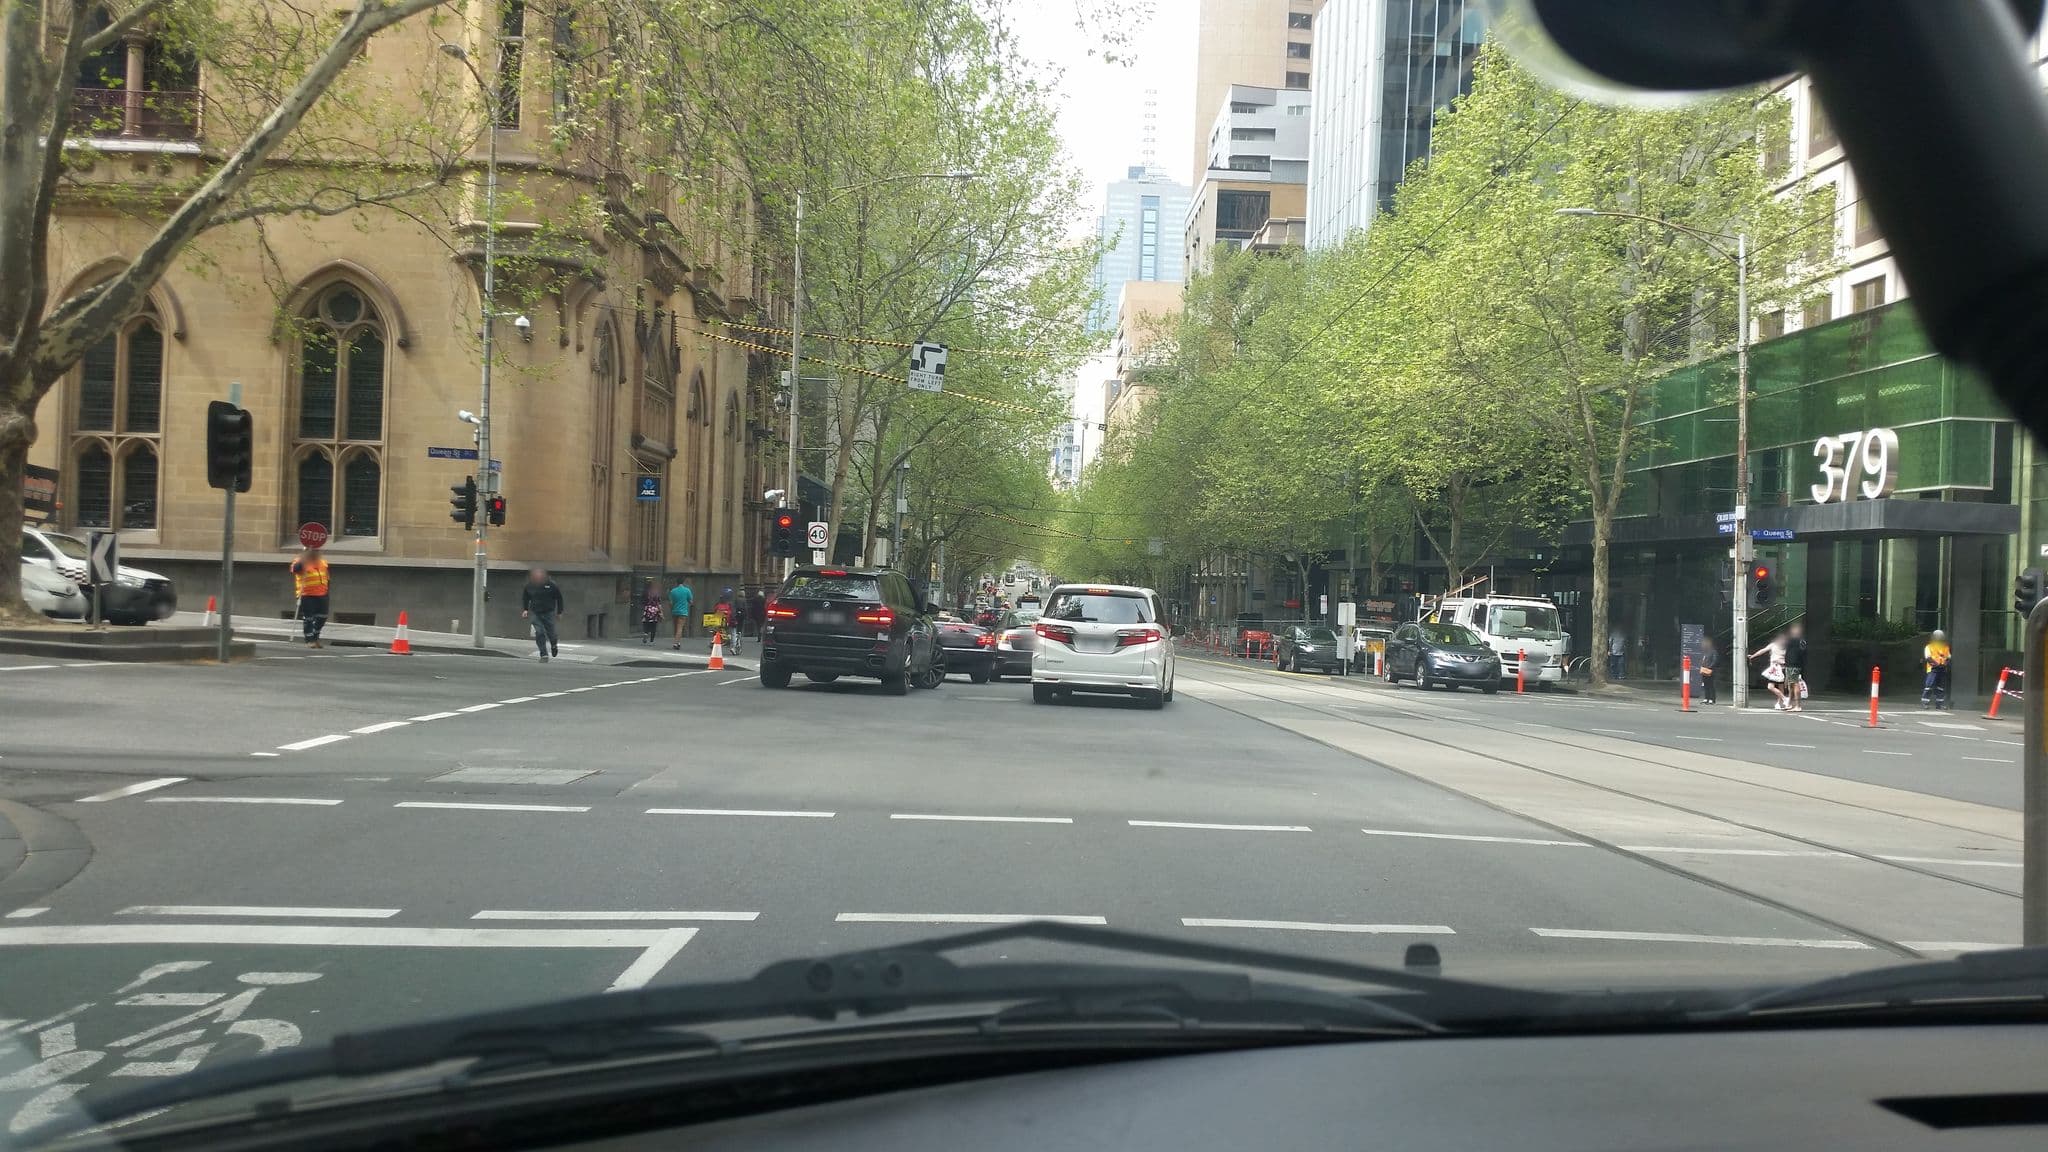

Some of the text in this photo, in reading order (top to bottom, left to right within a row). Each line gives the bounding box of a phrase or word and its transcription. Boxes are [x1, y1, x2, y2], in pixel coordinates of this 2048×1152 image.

[430, 447, 452, 455] Queen
[1811, 427, 1897, 503] 379
[300, 530, 326, 541] STOP
[811, 530, 825, 539] 40
